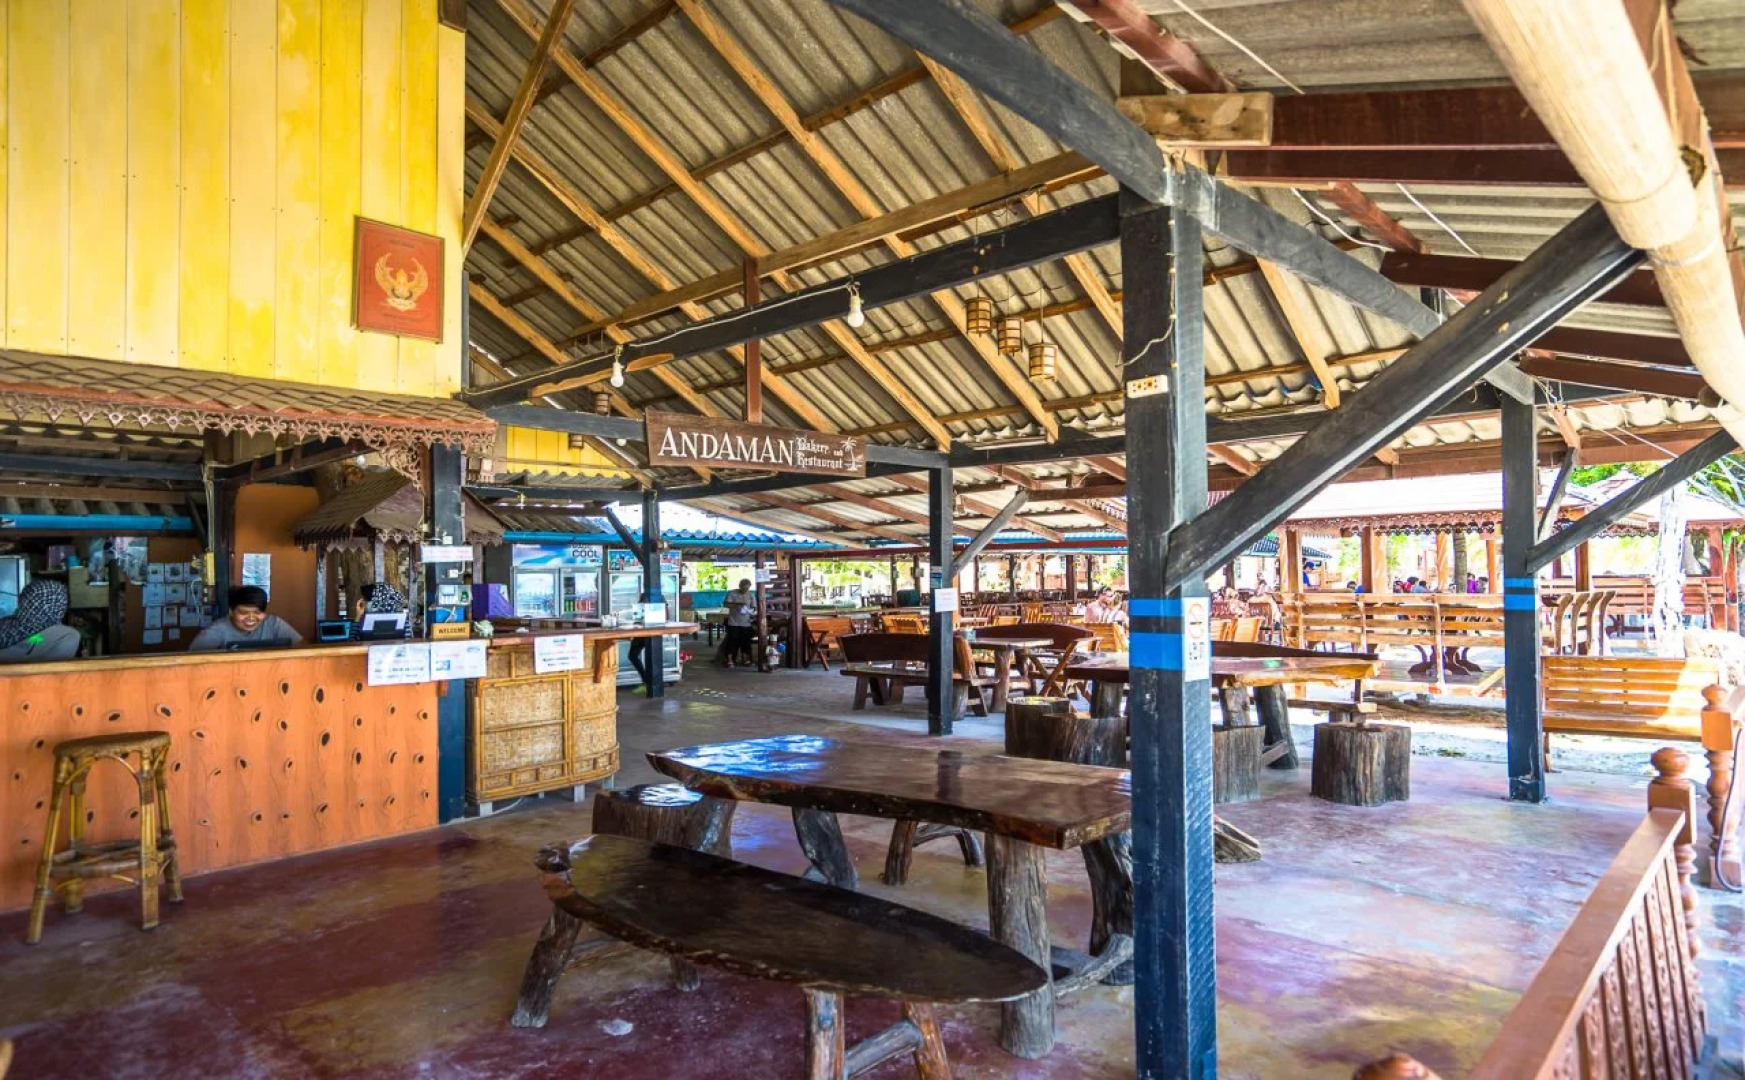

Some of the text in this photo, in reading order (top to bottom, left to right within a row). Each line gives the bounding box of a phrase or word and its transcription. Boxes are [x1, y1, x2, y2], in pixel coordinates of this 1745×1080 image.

[657, 426, 794, 466] ANDAMAN
[795, 436, 830, 455] Bakery
[795, 450, 844, 469] Restaurant
[572, 549, 598, 559] COOL
[437, 626, 466, 635] WELCOME
